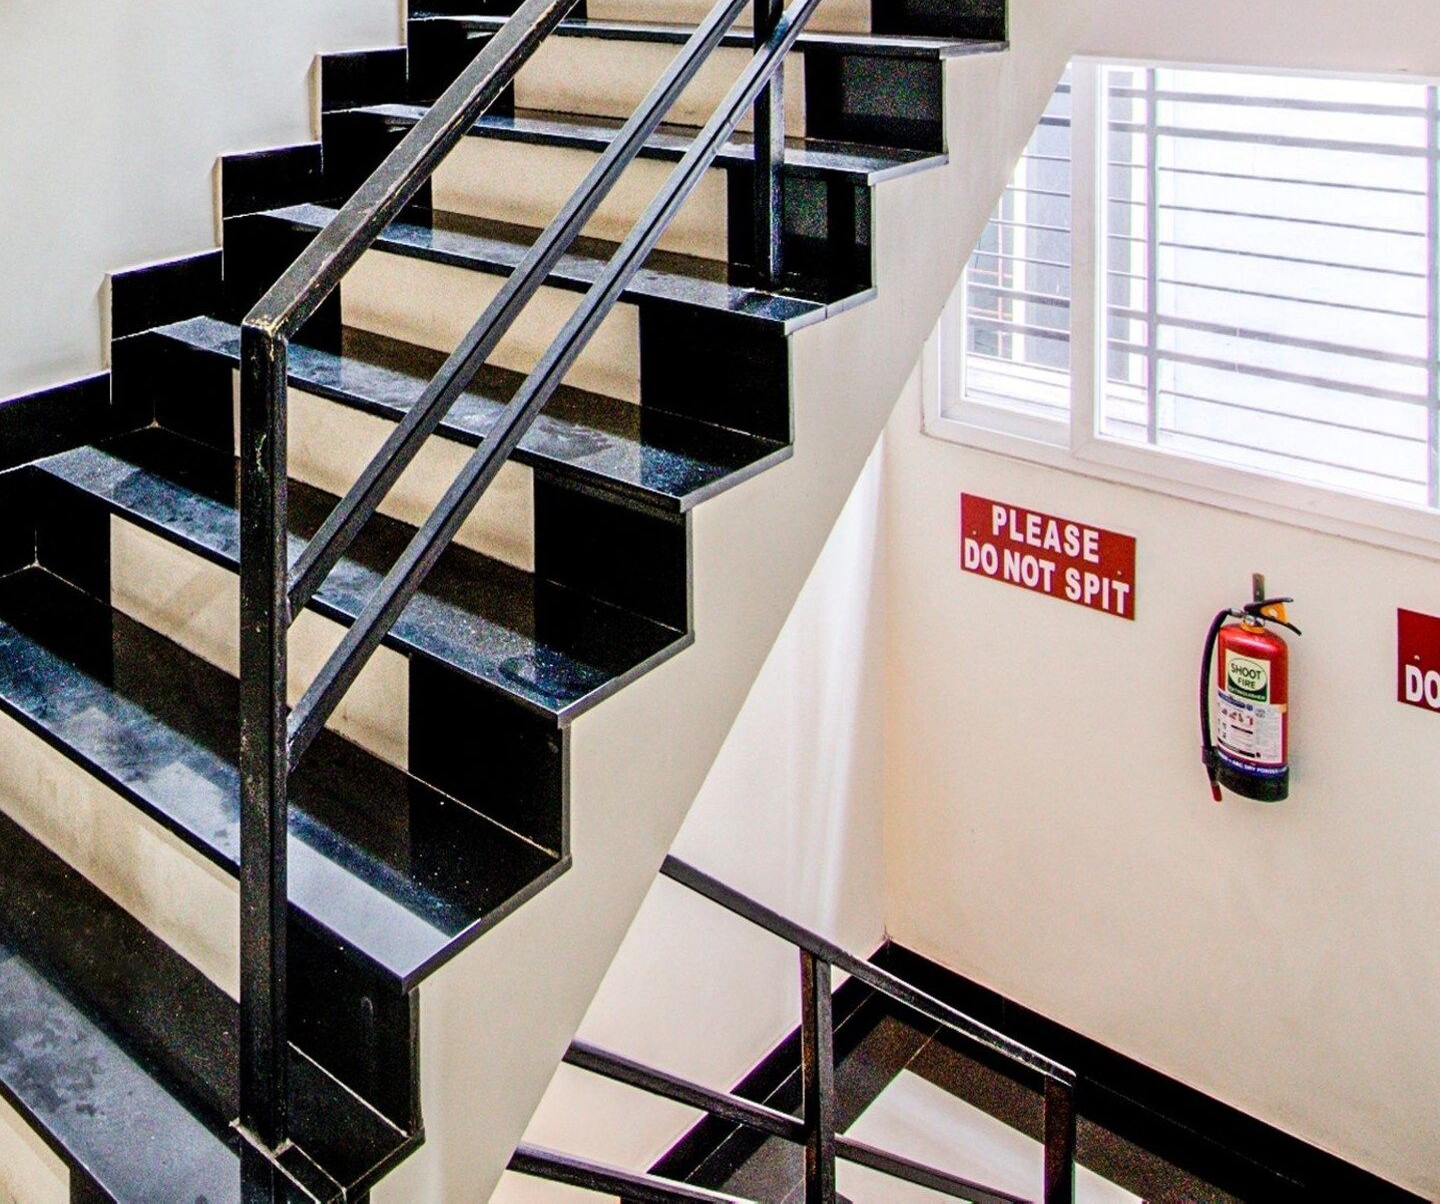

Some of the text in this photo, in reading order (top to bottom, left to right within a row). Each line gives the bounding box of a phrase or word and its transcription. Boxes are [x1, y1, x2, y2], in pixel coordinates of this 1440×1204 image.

[992, 504, 1100, 564] PLEASE
[964, 537, 1130, 615] DO NOT SPIT
[1231, 663, 1262, 680] SHOOT
[1237, 677, 1257, 690] FIRE
[1404, 663, 1440, 710] DO
